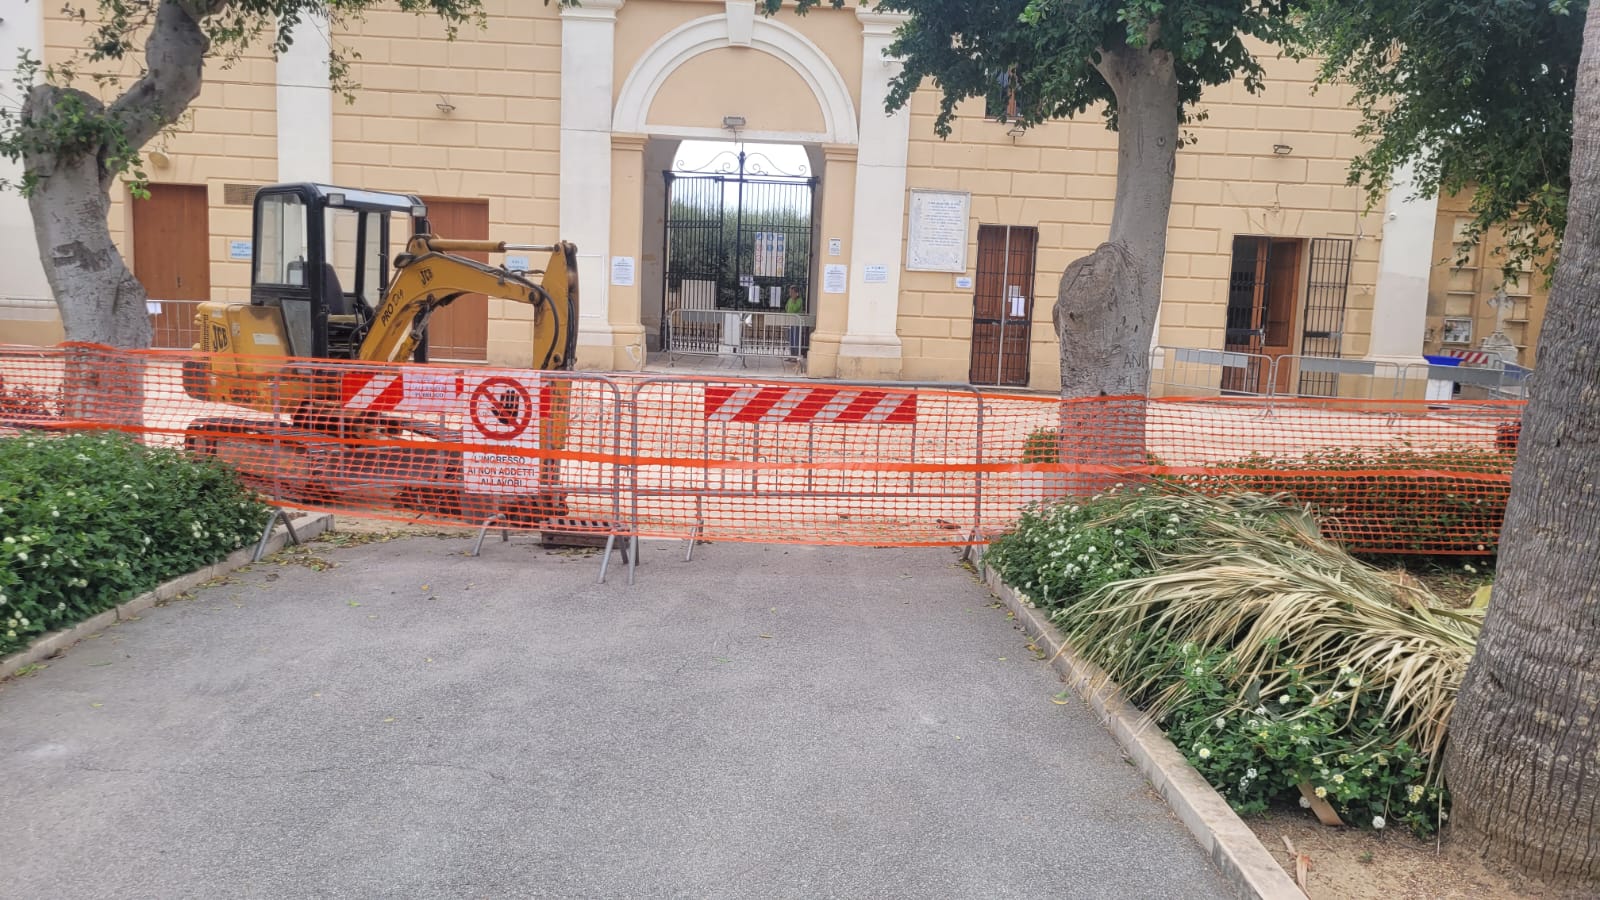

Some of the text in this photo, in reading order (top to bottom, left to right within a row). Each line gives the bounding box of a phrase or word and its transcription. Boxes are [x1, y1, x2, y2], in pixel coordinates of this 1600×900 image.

[381, 303, 394, 327] PRO
[212, 325, 227, 352] JCB
[474, 456, 526, 464] L'INGRESSO
[479, 467, 497, 475] NON
[499, 468, 535, 476] ADDETTI
[491, 478, 522, 487] LAVORI
